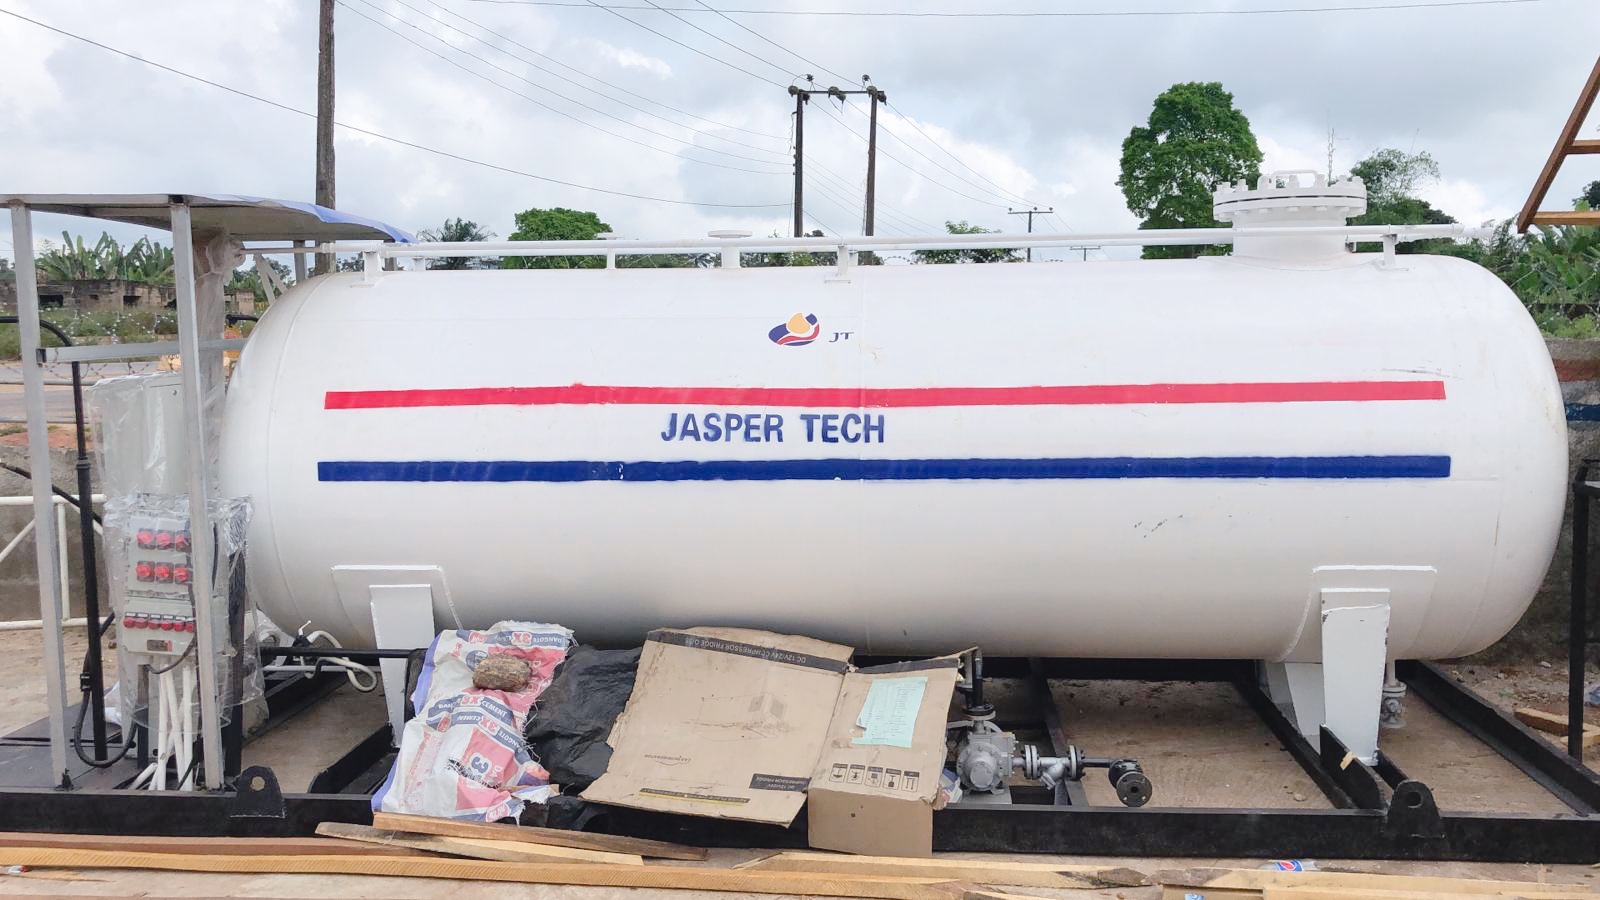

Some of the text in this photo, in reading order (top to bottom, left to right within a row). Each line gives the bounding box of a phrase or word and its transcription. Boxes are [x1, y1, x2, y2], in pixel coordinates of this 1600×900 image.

[828, 331, 854, 343] JT
[660, 412, 885, 444] JASPER TECH
[481, 700, 508, 717] CEMENT
